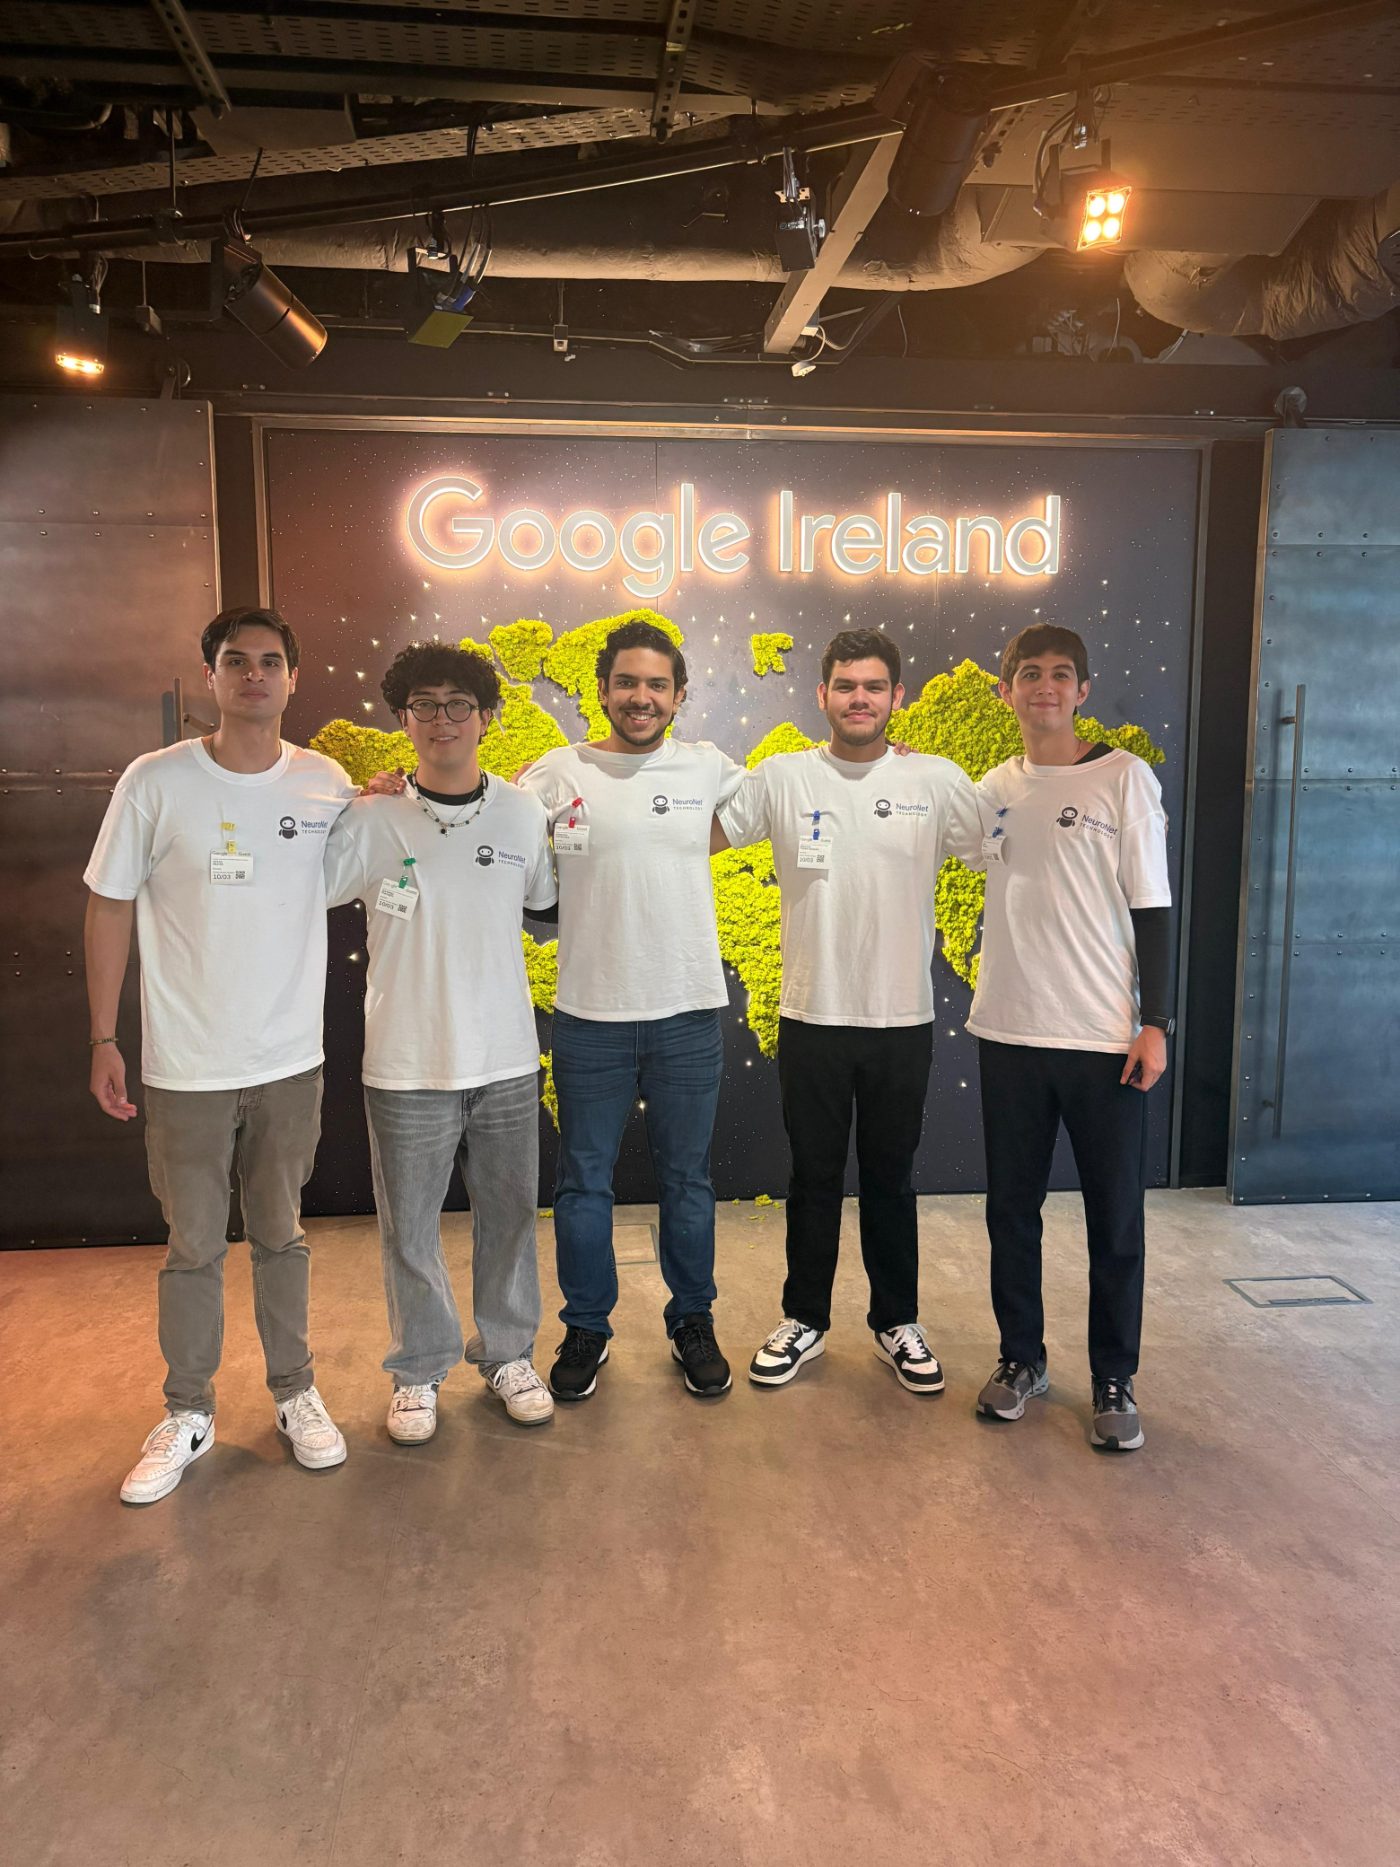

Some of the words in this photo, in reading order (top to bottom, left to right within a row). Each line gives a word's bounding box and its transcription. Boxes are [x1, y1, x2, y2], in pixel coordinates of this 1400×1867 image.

[407, 475, 749, 598] Google
[779, 489, 1061, 575] Ireland
[672, 798, 703, 806] NeuroNet
[895, 803, 929, 812] NeuroNet
[1080, 823, 1113, 839] TECHNOLOGY
[1081, 814, 1118, 835] NeuroNet
[498, 850, 526, 864] NeuroNet
